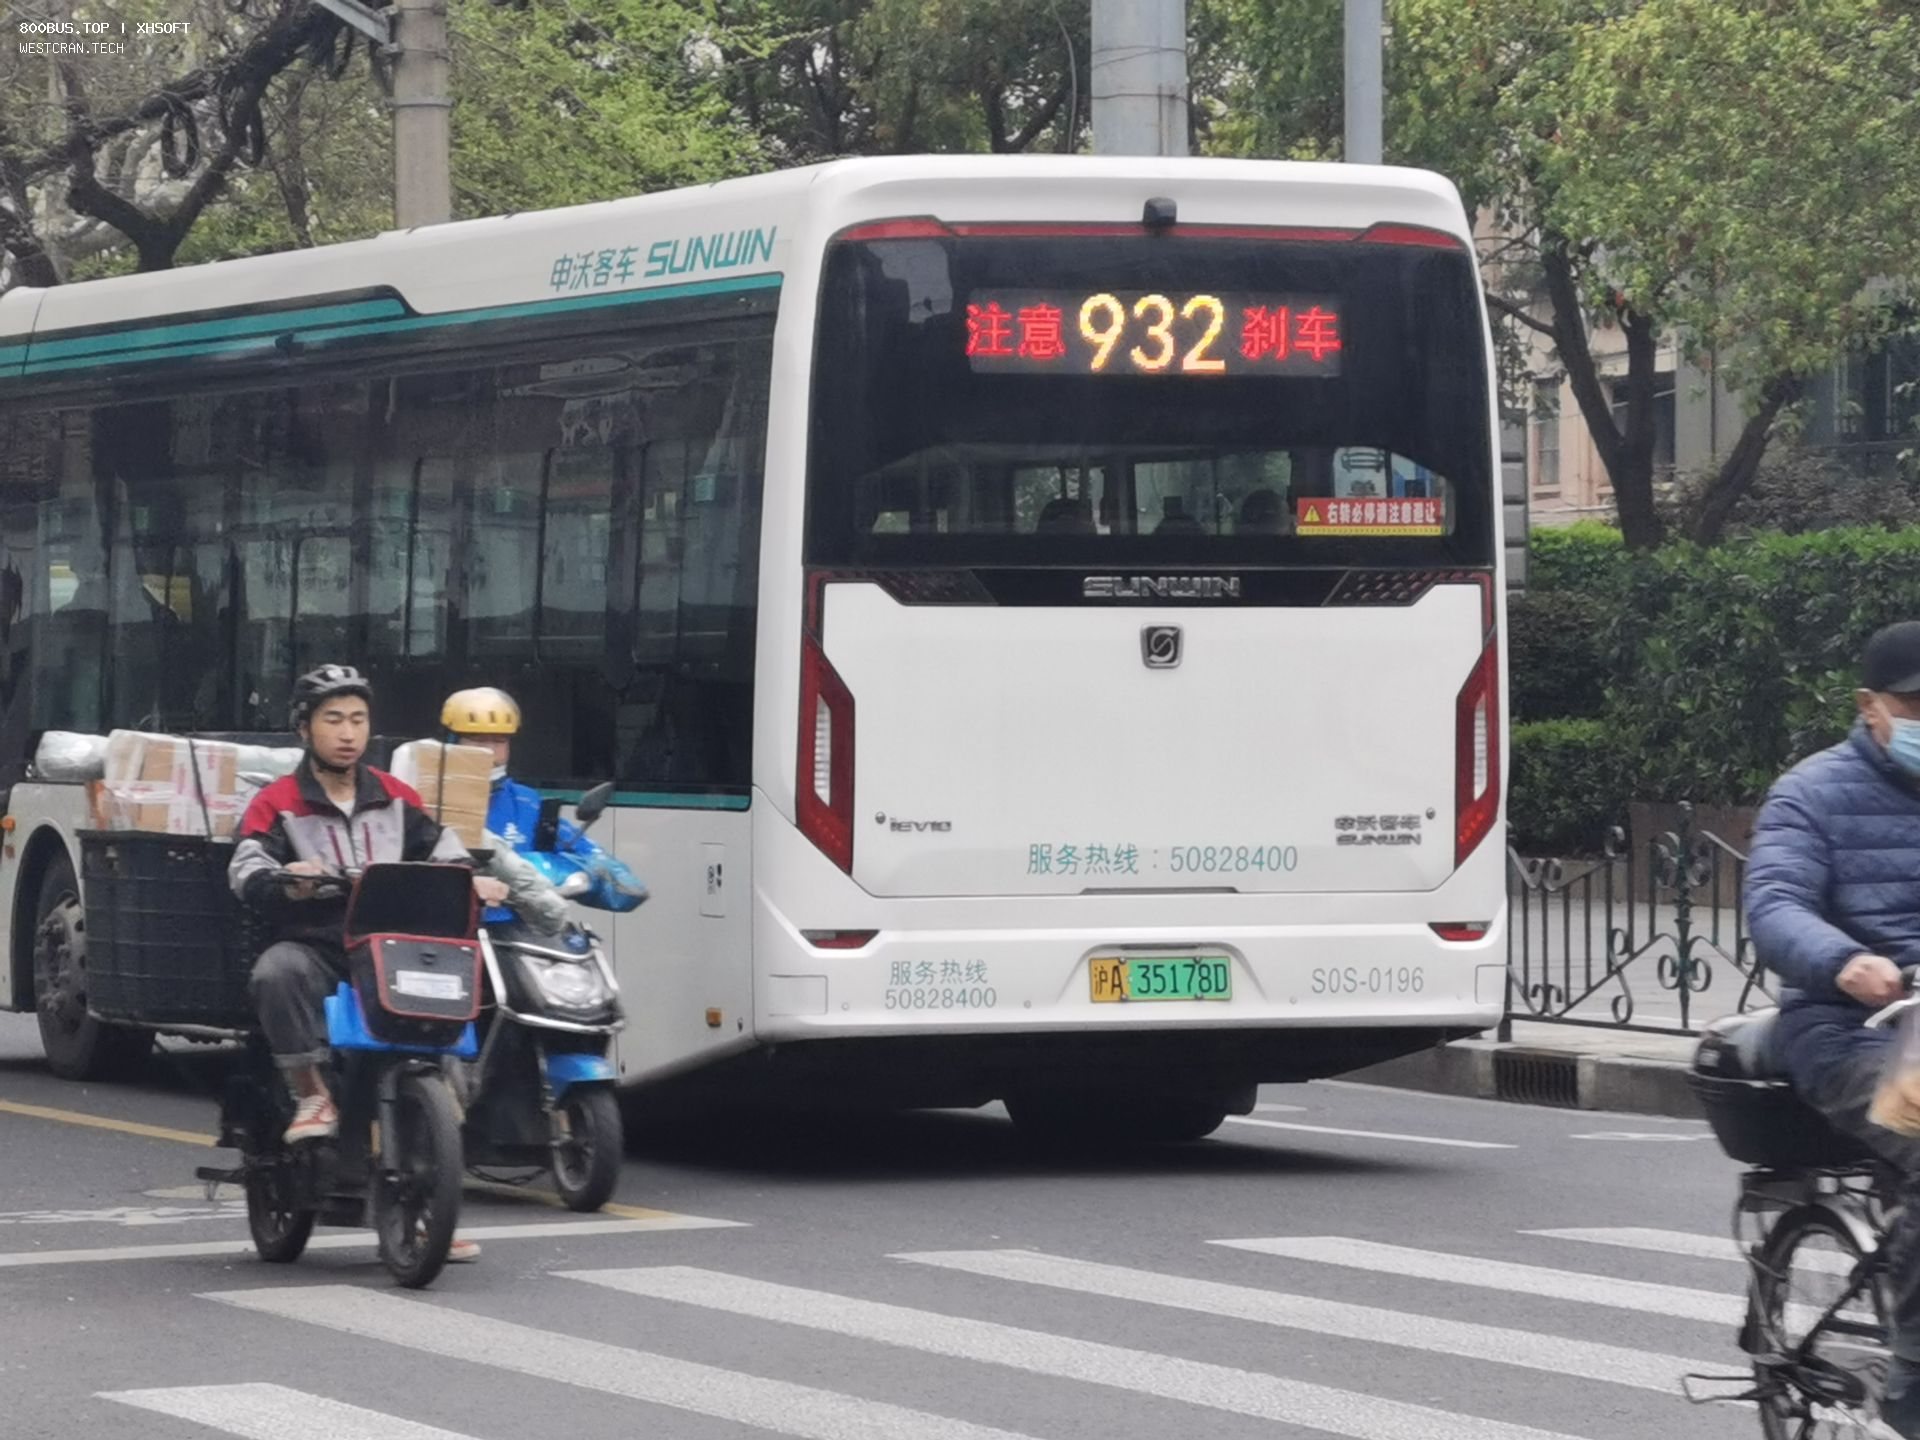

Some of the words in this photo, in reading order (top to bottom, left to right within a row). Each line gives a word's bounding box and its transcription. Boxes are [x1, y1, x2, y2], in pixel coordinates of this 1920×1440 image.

[550, 246, 640, 292] 申沃客车
[643, 226, 777, 278] SUNWIN
[966, 301, 1066, 359] 注意
[1079, 293, 1226, 373] 932
[1240, 304, 1343, 361] 刹车
[1083, 576, 1241, 598] SUNWIN
[1334, 814, 1422, 831] 申沃客车
[1336, 833, 1422, 846] SUNWIN
[889, 959, 988, 986] 服务热线
[884, 987, 997, 1010] 50828400
